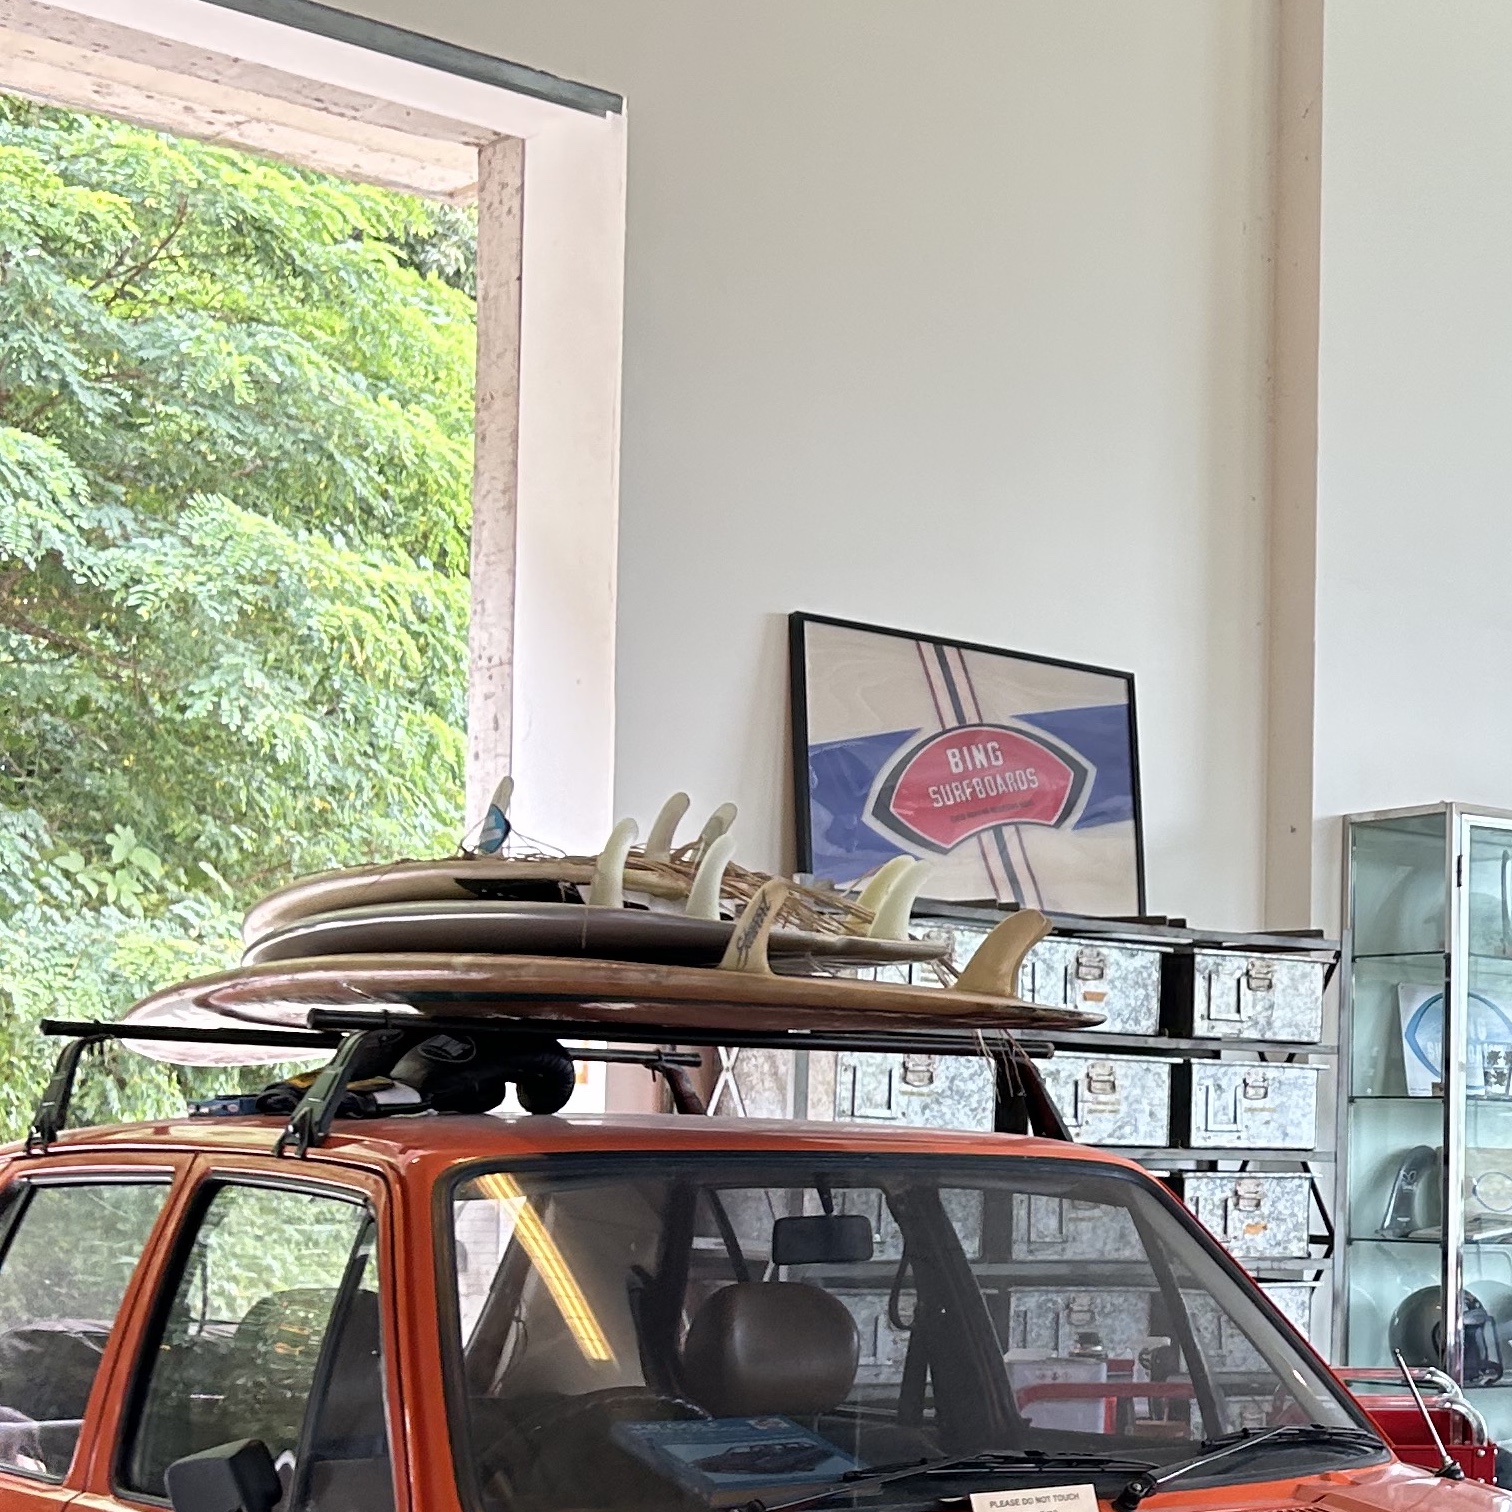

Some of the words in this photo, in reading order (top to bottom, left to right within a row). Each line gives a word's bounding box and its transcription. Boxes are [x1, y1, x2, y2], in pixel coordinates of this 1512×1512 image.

[946, 741, 1004, 774] BING
[928, 767, 1039, 808] SURFBOARDS
[989, 1498, 1020, 1508] PLEASE
[1022, 1497, 1034, 1506] DO
[1035, 1495, 1051, 1504] NOT
[1052, 1492, 1080, 1502] TOUCH
